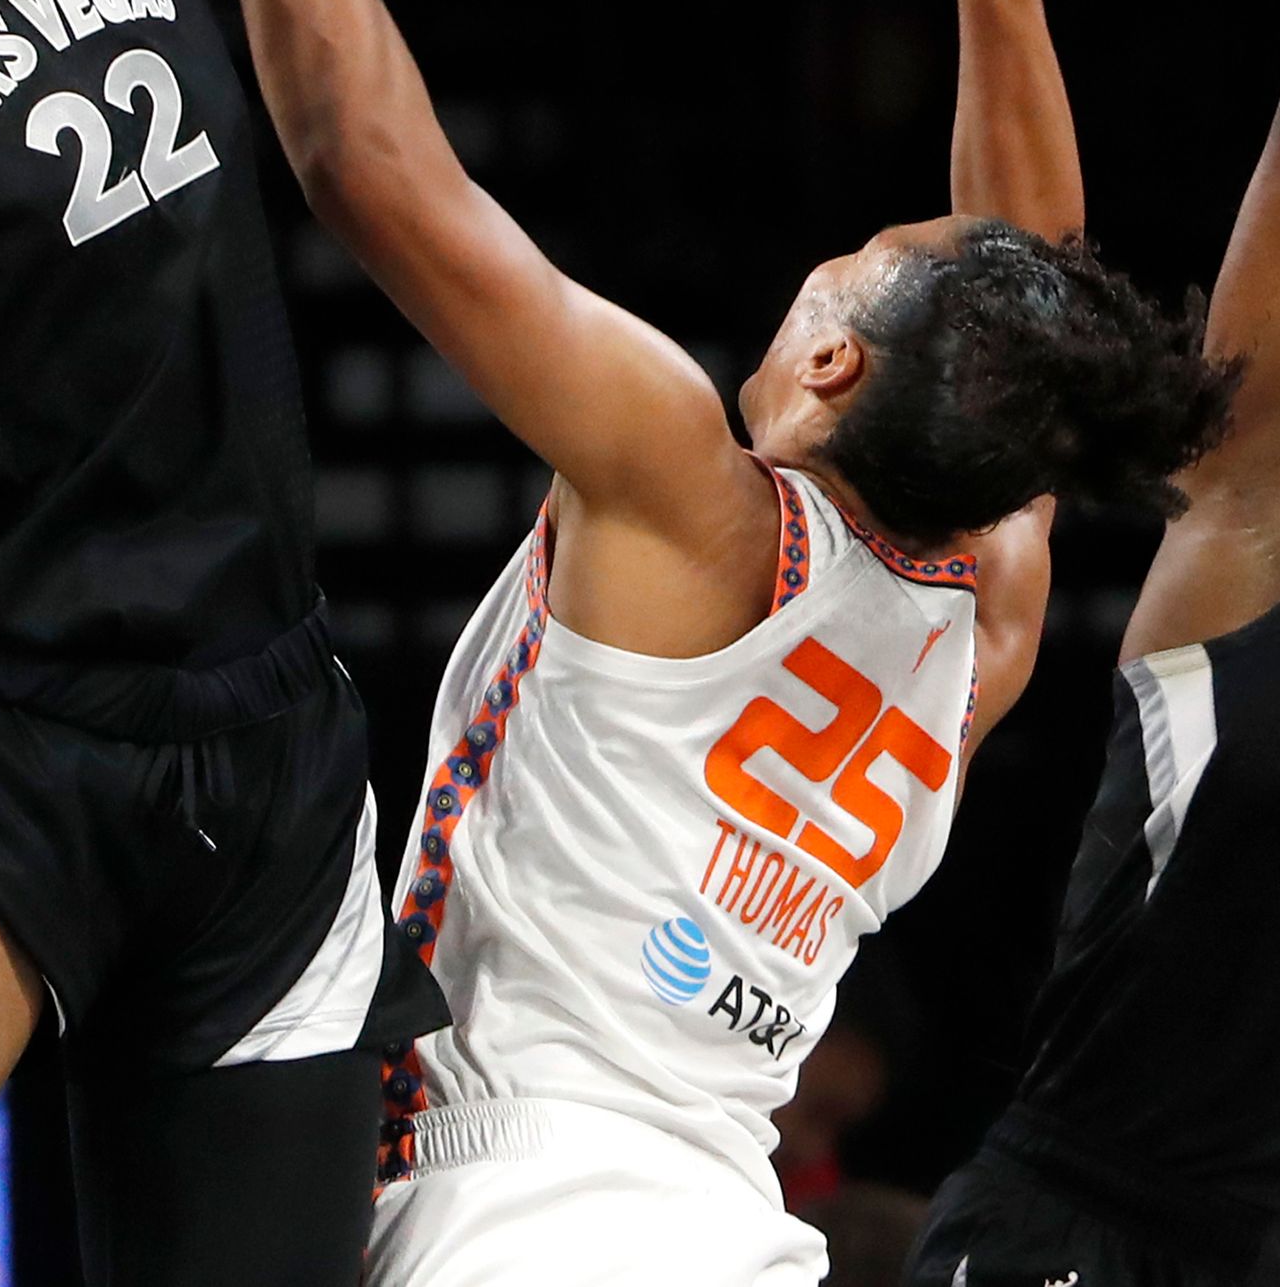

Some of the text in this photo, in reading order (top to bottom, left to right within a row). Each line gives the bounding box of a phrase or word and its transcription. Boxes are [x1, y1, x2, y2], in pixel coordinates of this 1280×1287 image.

[26, 48, 221, 247] 22
[704, 635, 953, 890] 25
[698, 818, 845, 967] THOMAS
[707, 974, 808, 1062] AT&T
